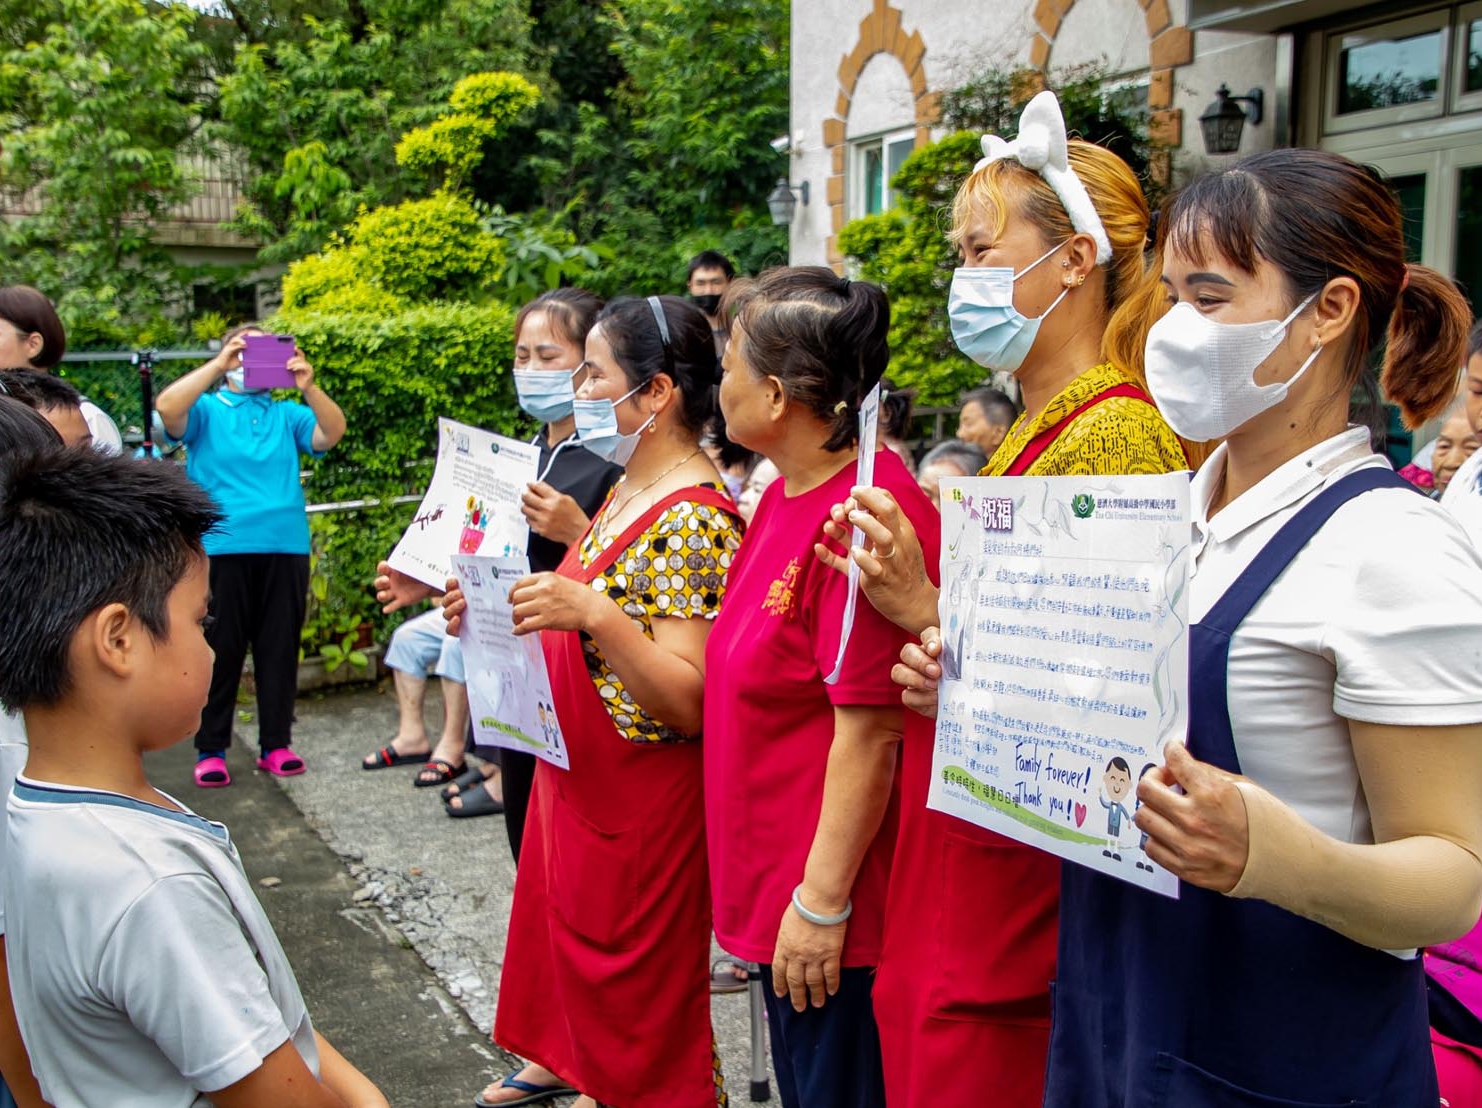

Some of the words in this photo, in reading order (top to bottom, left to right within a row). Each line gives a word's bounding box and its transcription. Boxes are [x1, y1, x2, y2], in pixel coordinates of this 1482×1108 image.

[982, 497, 1013, 530] 祝福
[1015, 743, 1042, 780] Family
[1045, 753, 1091, 794] forever!
[1015, 781, 1042, 808] Thank
